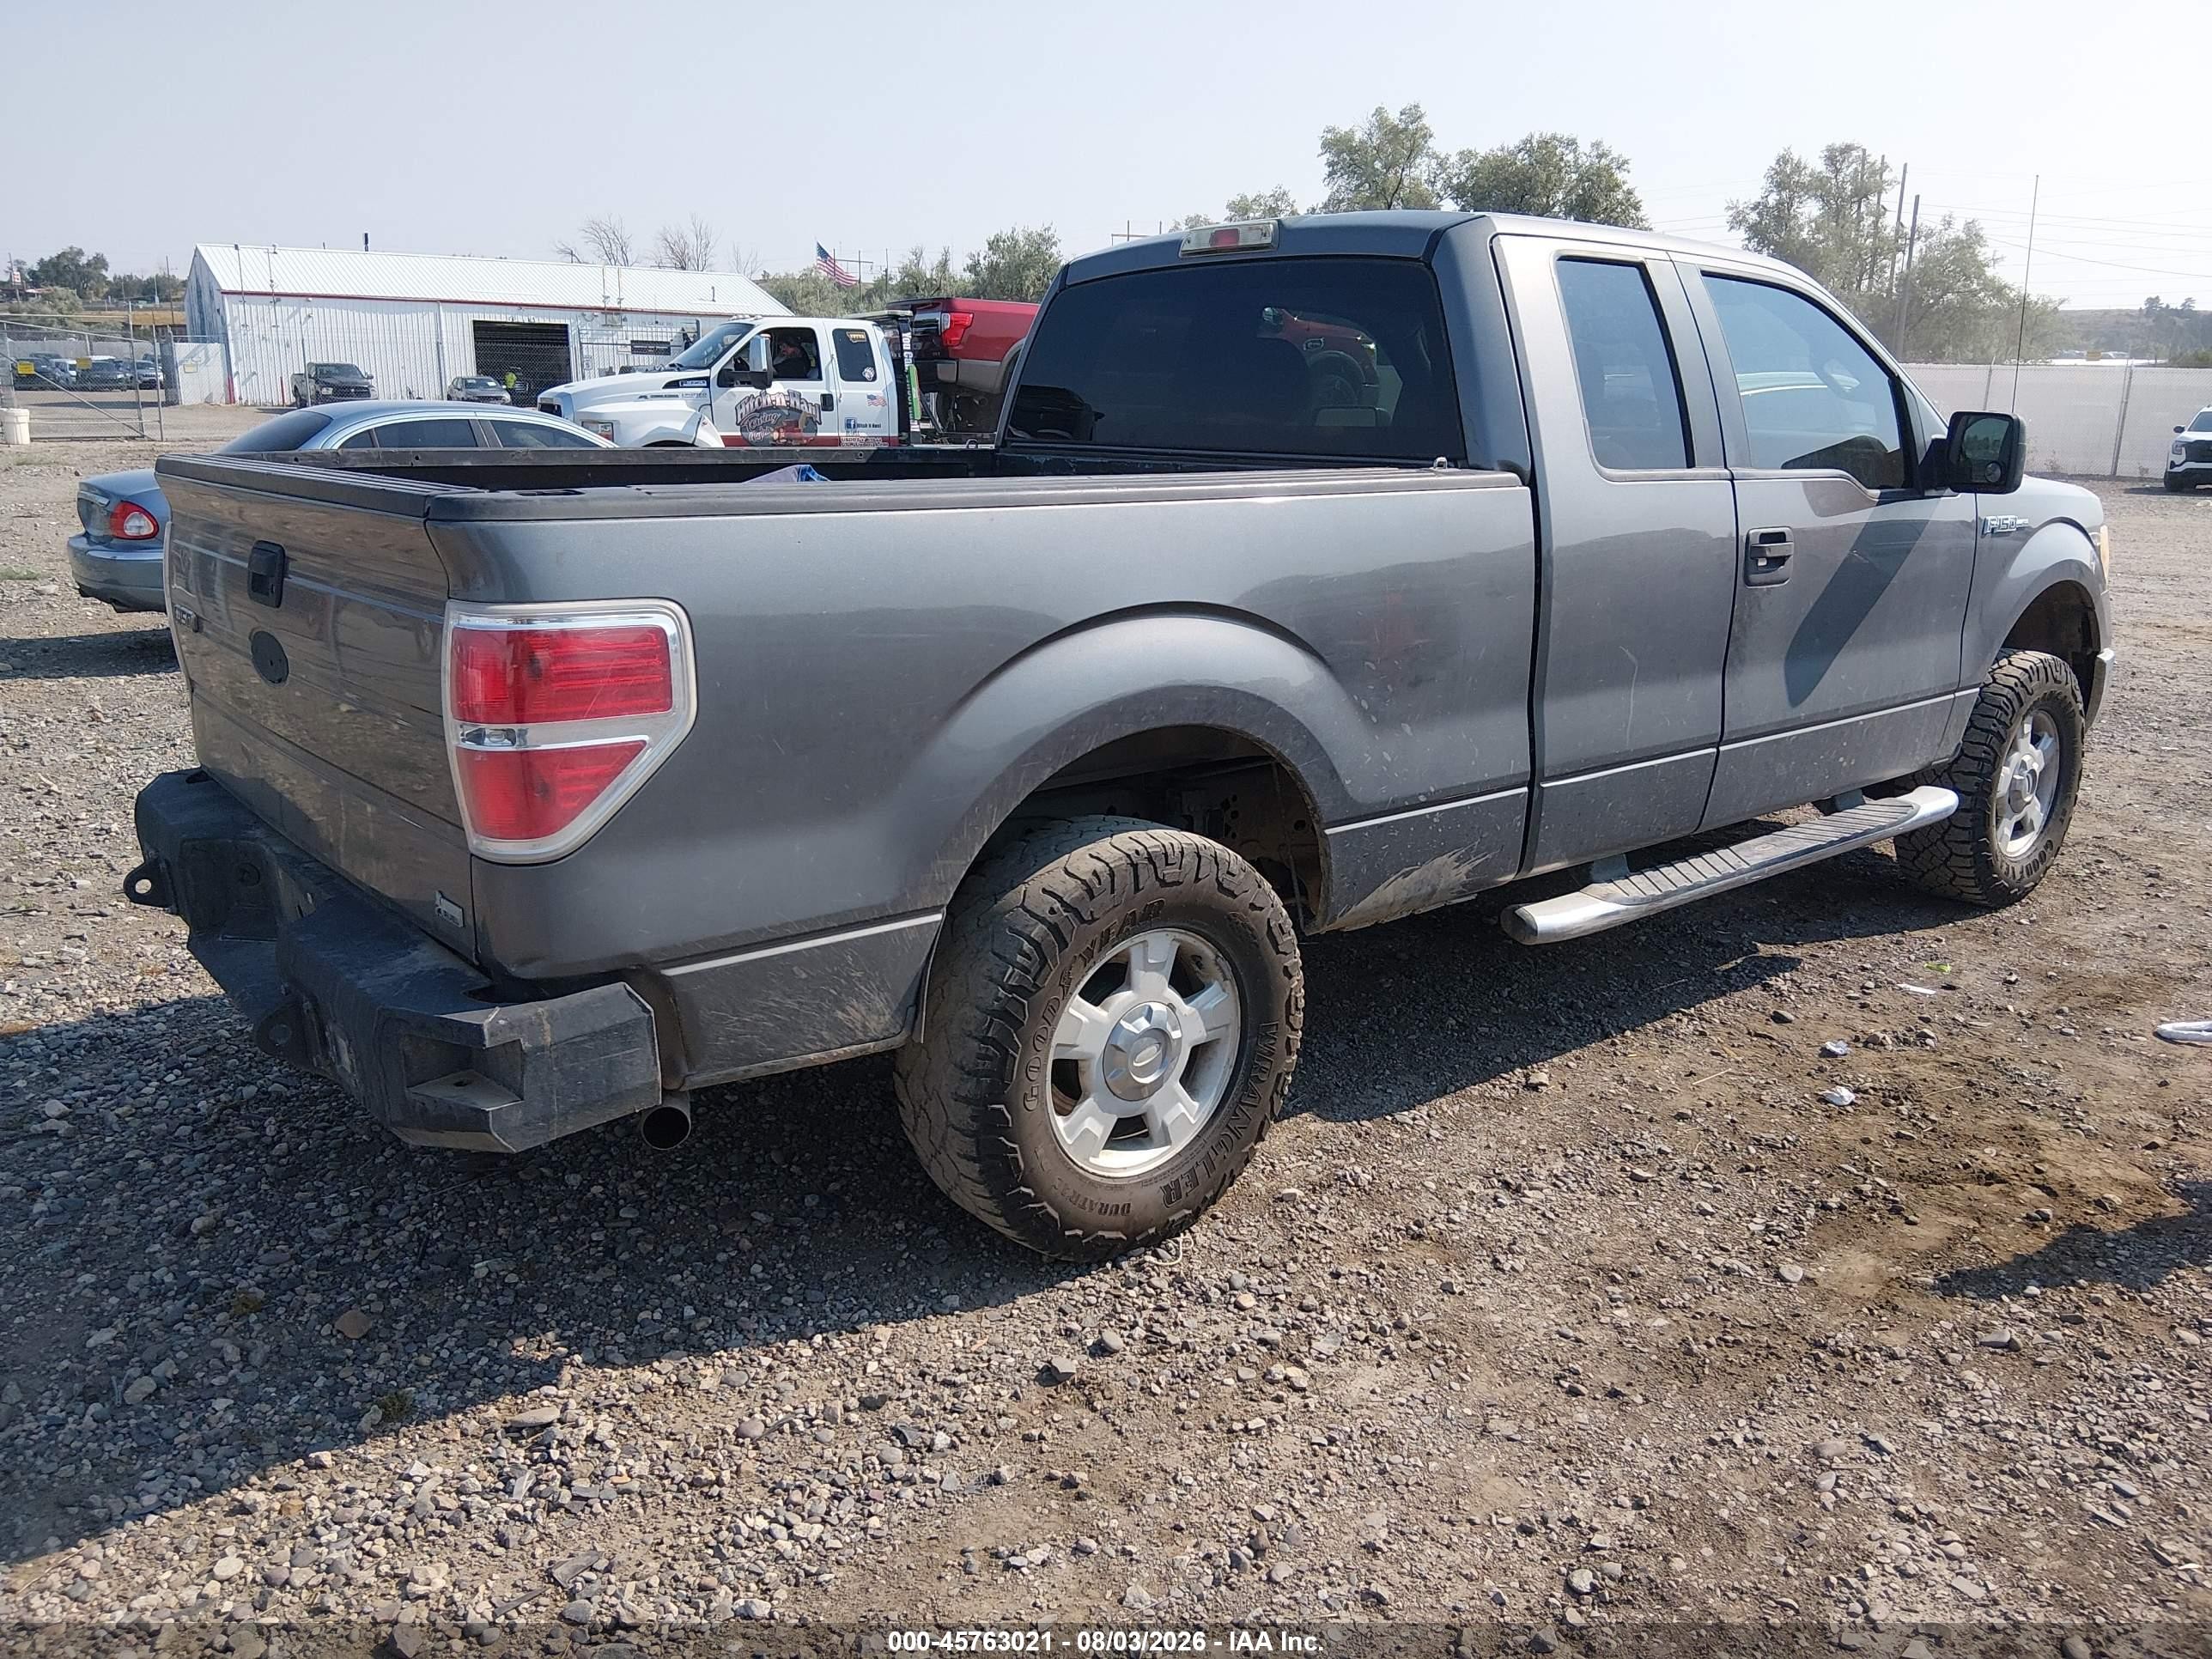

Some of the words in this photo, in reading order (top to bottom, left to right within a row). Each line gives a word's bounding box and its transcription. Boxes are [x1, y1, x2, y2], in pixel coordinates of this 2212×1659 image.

[902, 331, 912, 350] You
[741, 412, 781, 433] Towing
[1023, 898, 1166, 1112] GOODYEAR
[1158, 1020, 1279, 1209] WRANGLER
